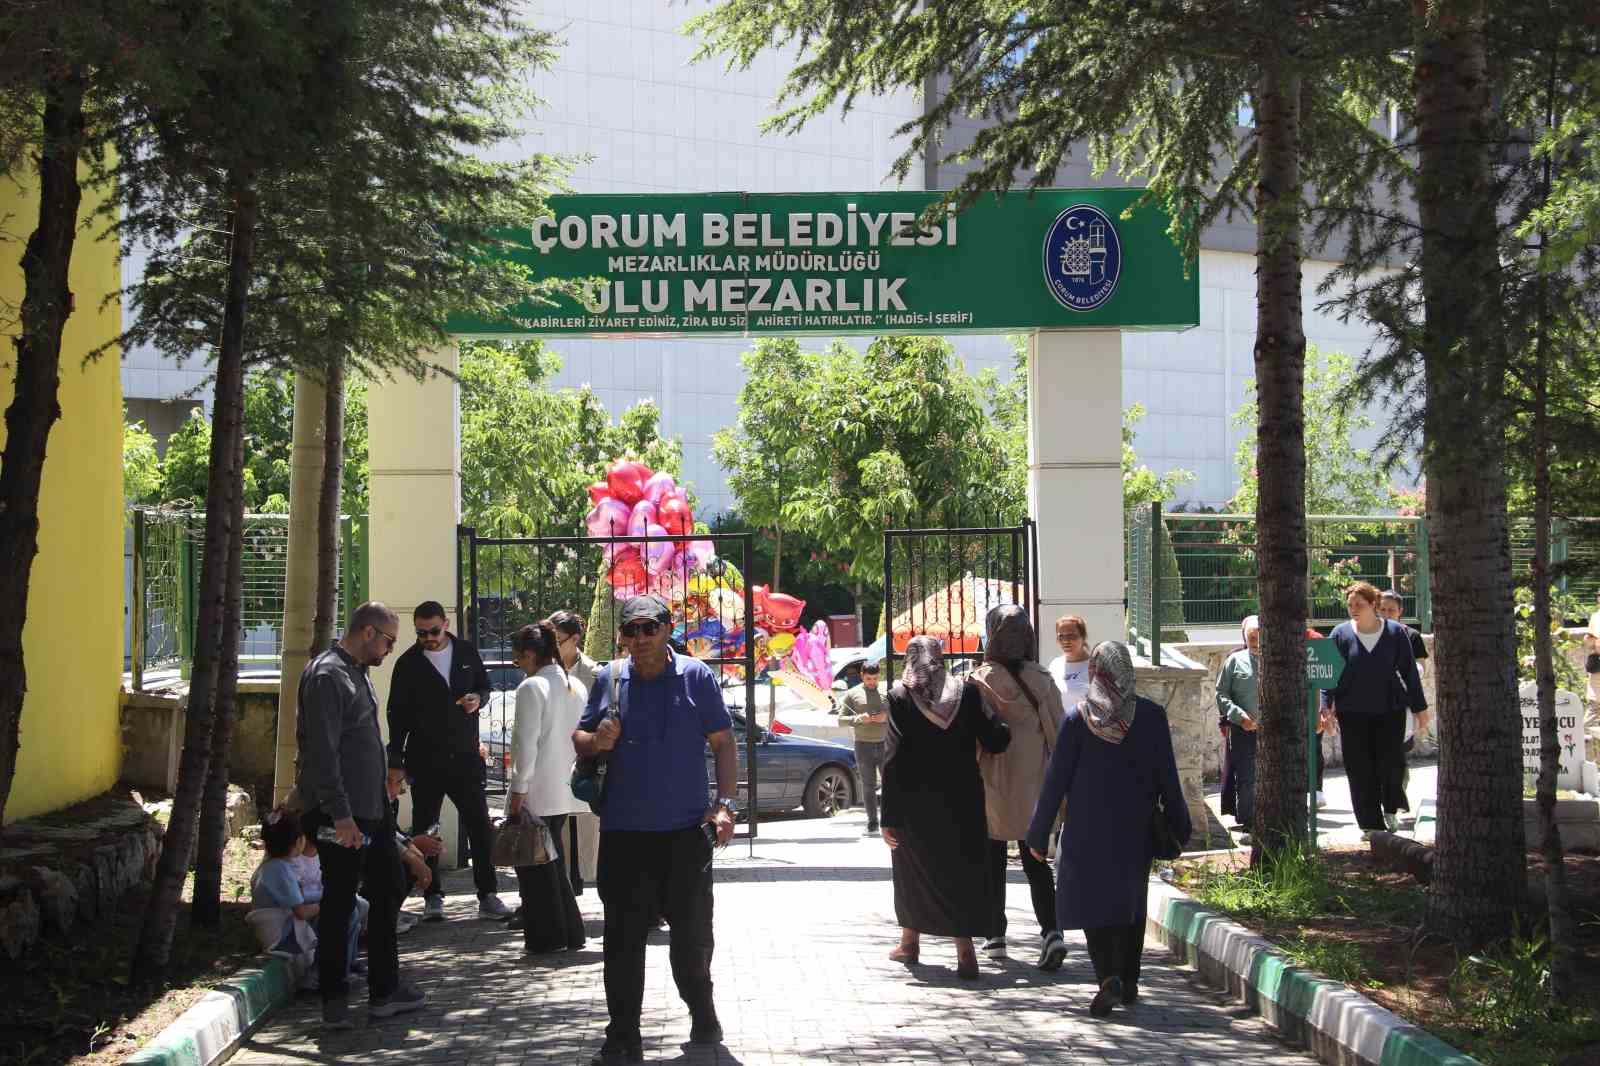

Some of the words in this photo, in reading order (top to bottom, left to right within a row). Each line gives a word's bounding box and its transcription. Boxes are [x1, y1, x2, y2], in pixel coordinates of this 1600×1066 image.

[531, 213, 687, 254] ÇORUM
[702, 202, 958, 248] BELEDİYESİ
[608, 254, 750, 273] MEZARLIKLAR
[755, 250, 881, 273] MÜDÜRLÜĞÜ
[583, 279, 669, 314] ULU
[683, 277, 908, 312] MEZARLIK
[588, 315, 635, 328] ZİYARET
[638, 314, 680, 329] EDİNİZ,
[682, 314, 709, 328] ZİRA
[711, 316, 727, 327] BU
[756, 313, 802, 326] AHİRETİ
